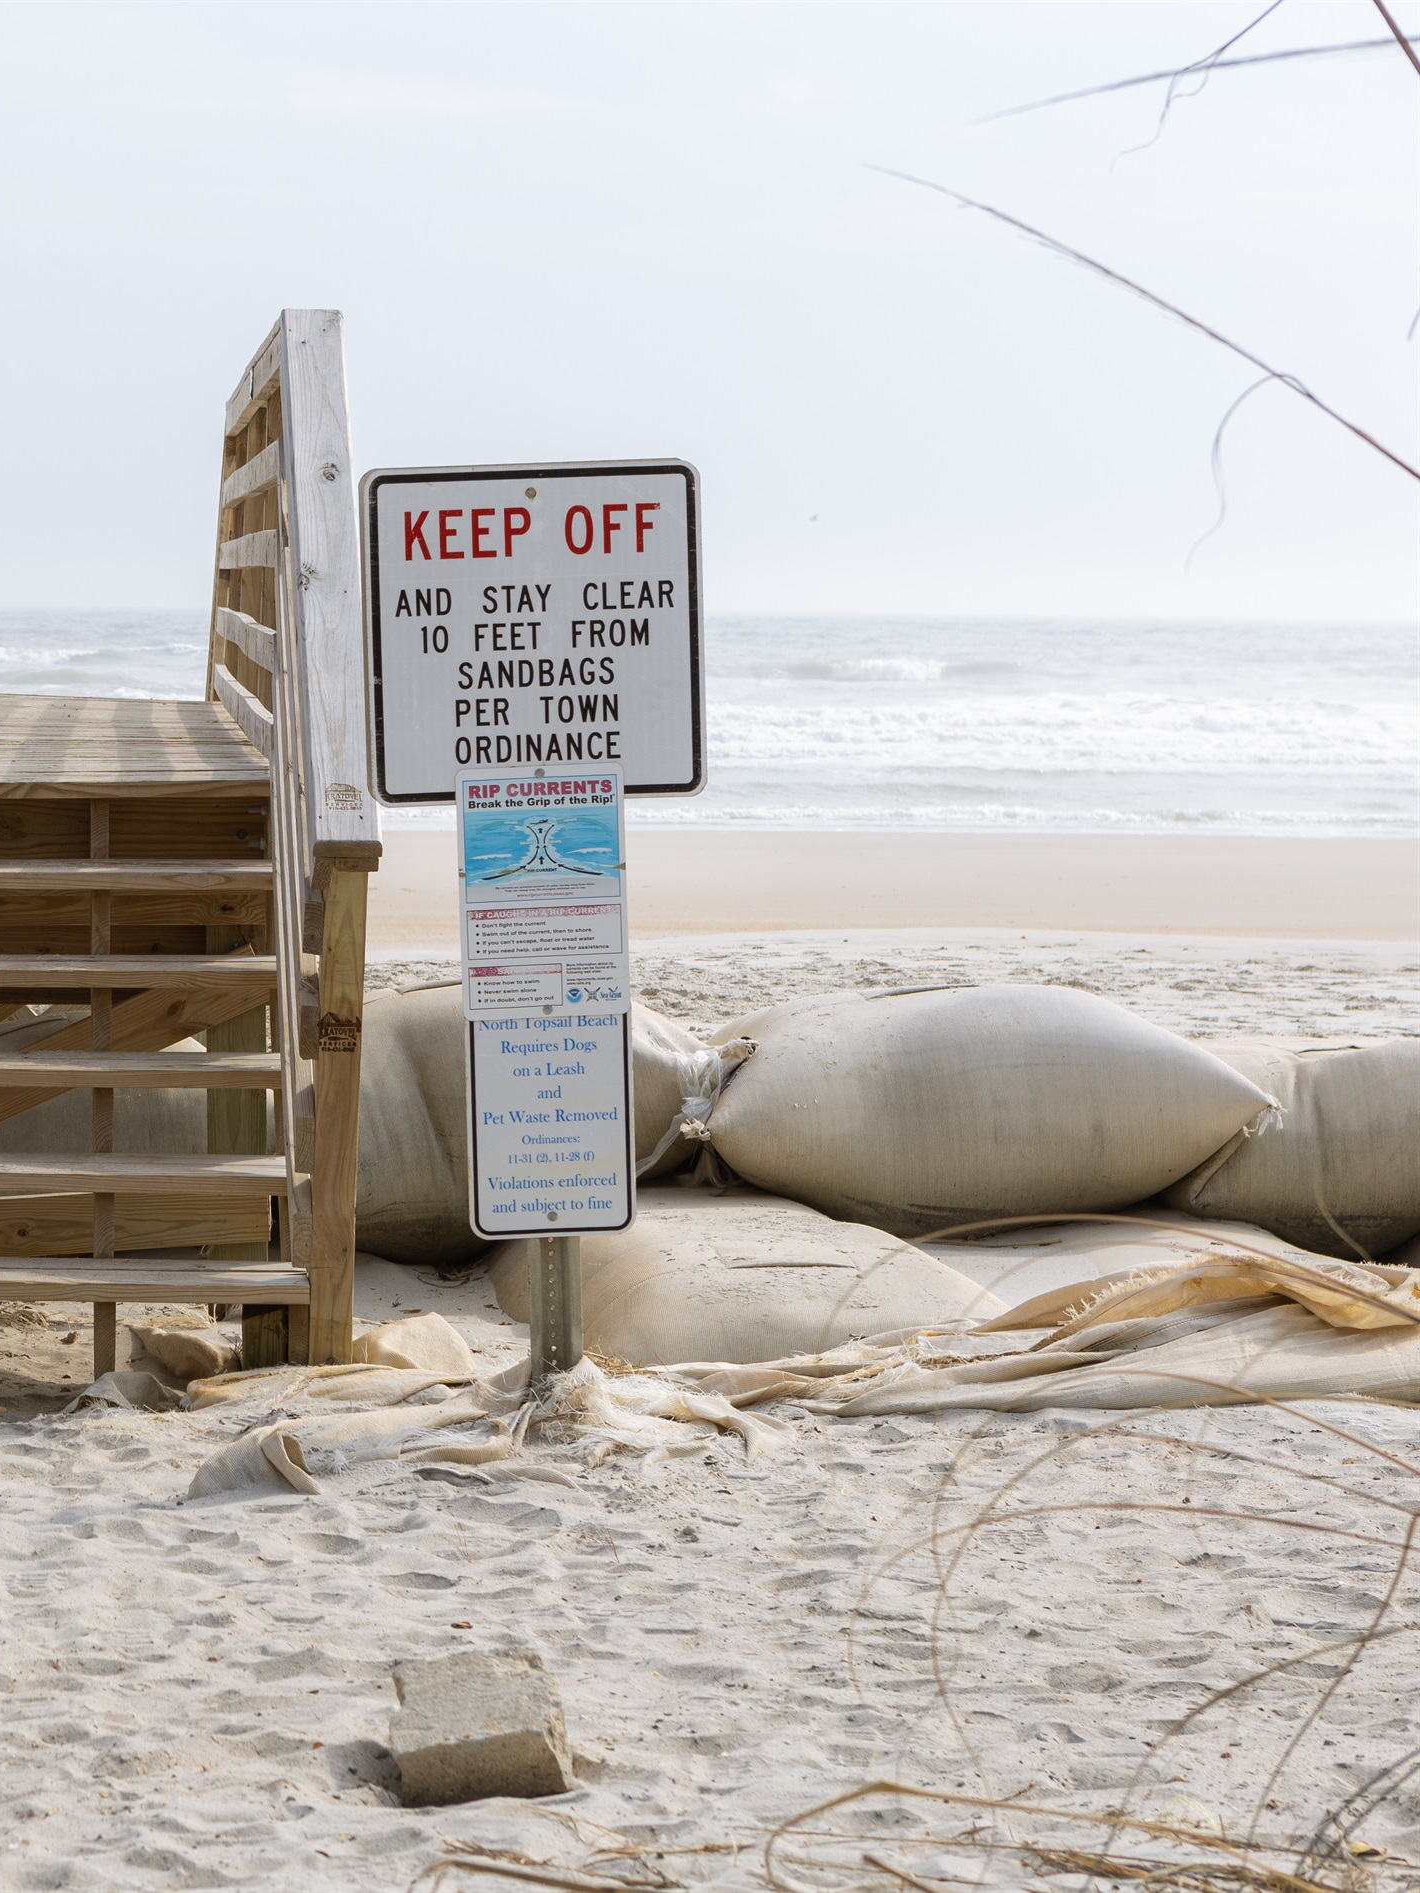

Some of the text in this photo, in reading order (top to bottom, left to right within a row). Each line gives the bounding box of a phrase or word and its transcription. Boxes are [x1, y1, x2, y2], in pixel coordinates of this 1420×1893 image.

[403, 502, 660, 561] KEEP OFF
[394, 579, 674, 617] AND STAY CLEAR
[420, 617, 649, 654] 10 FEET FROM
[457, 656, 614, 690] SANDBAGS
[455, 693, 618, 727] PER TOWN
[454, 730, 621, 764] ORDINANCE
[468, 779, 613, 799] RIP CURRENTS
[468, 799, 502, 809] Break
[504, 798, 523, 807] the
[526, 797, 550, 807] Grip
[553, 796, 565, 805] of
[568, 795, 587, 804] the
[549, 908, 566, 916] RIP
[479, 1018, 518, 1030] North
[577, 1014, 618, 1027] Beach
[500, 1038, 597, 1056] Requires Dogs
[512, 1061, 585, 1076] on a Leash
[537, 1084, 562, 1099] and
[483, 1106, 617, 1125] Pet Waste Removed
[521, 1134, 580, 1144] Ordinances:
[508, 1153, 532, 1164] 11-31
[555, 1151, 580, 1162] 11-28
[487, 1172, 616, 1190] Violations enforced
[492, 1195, 612, 1214] and subject to fine
